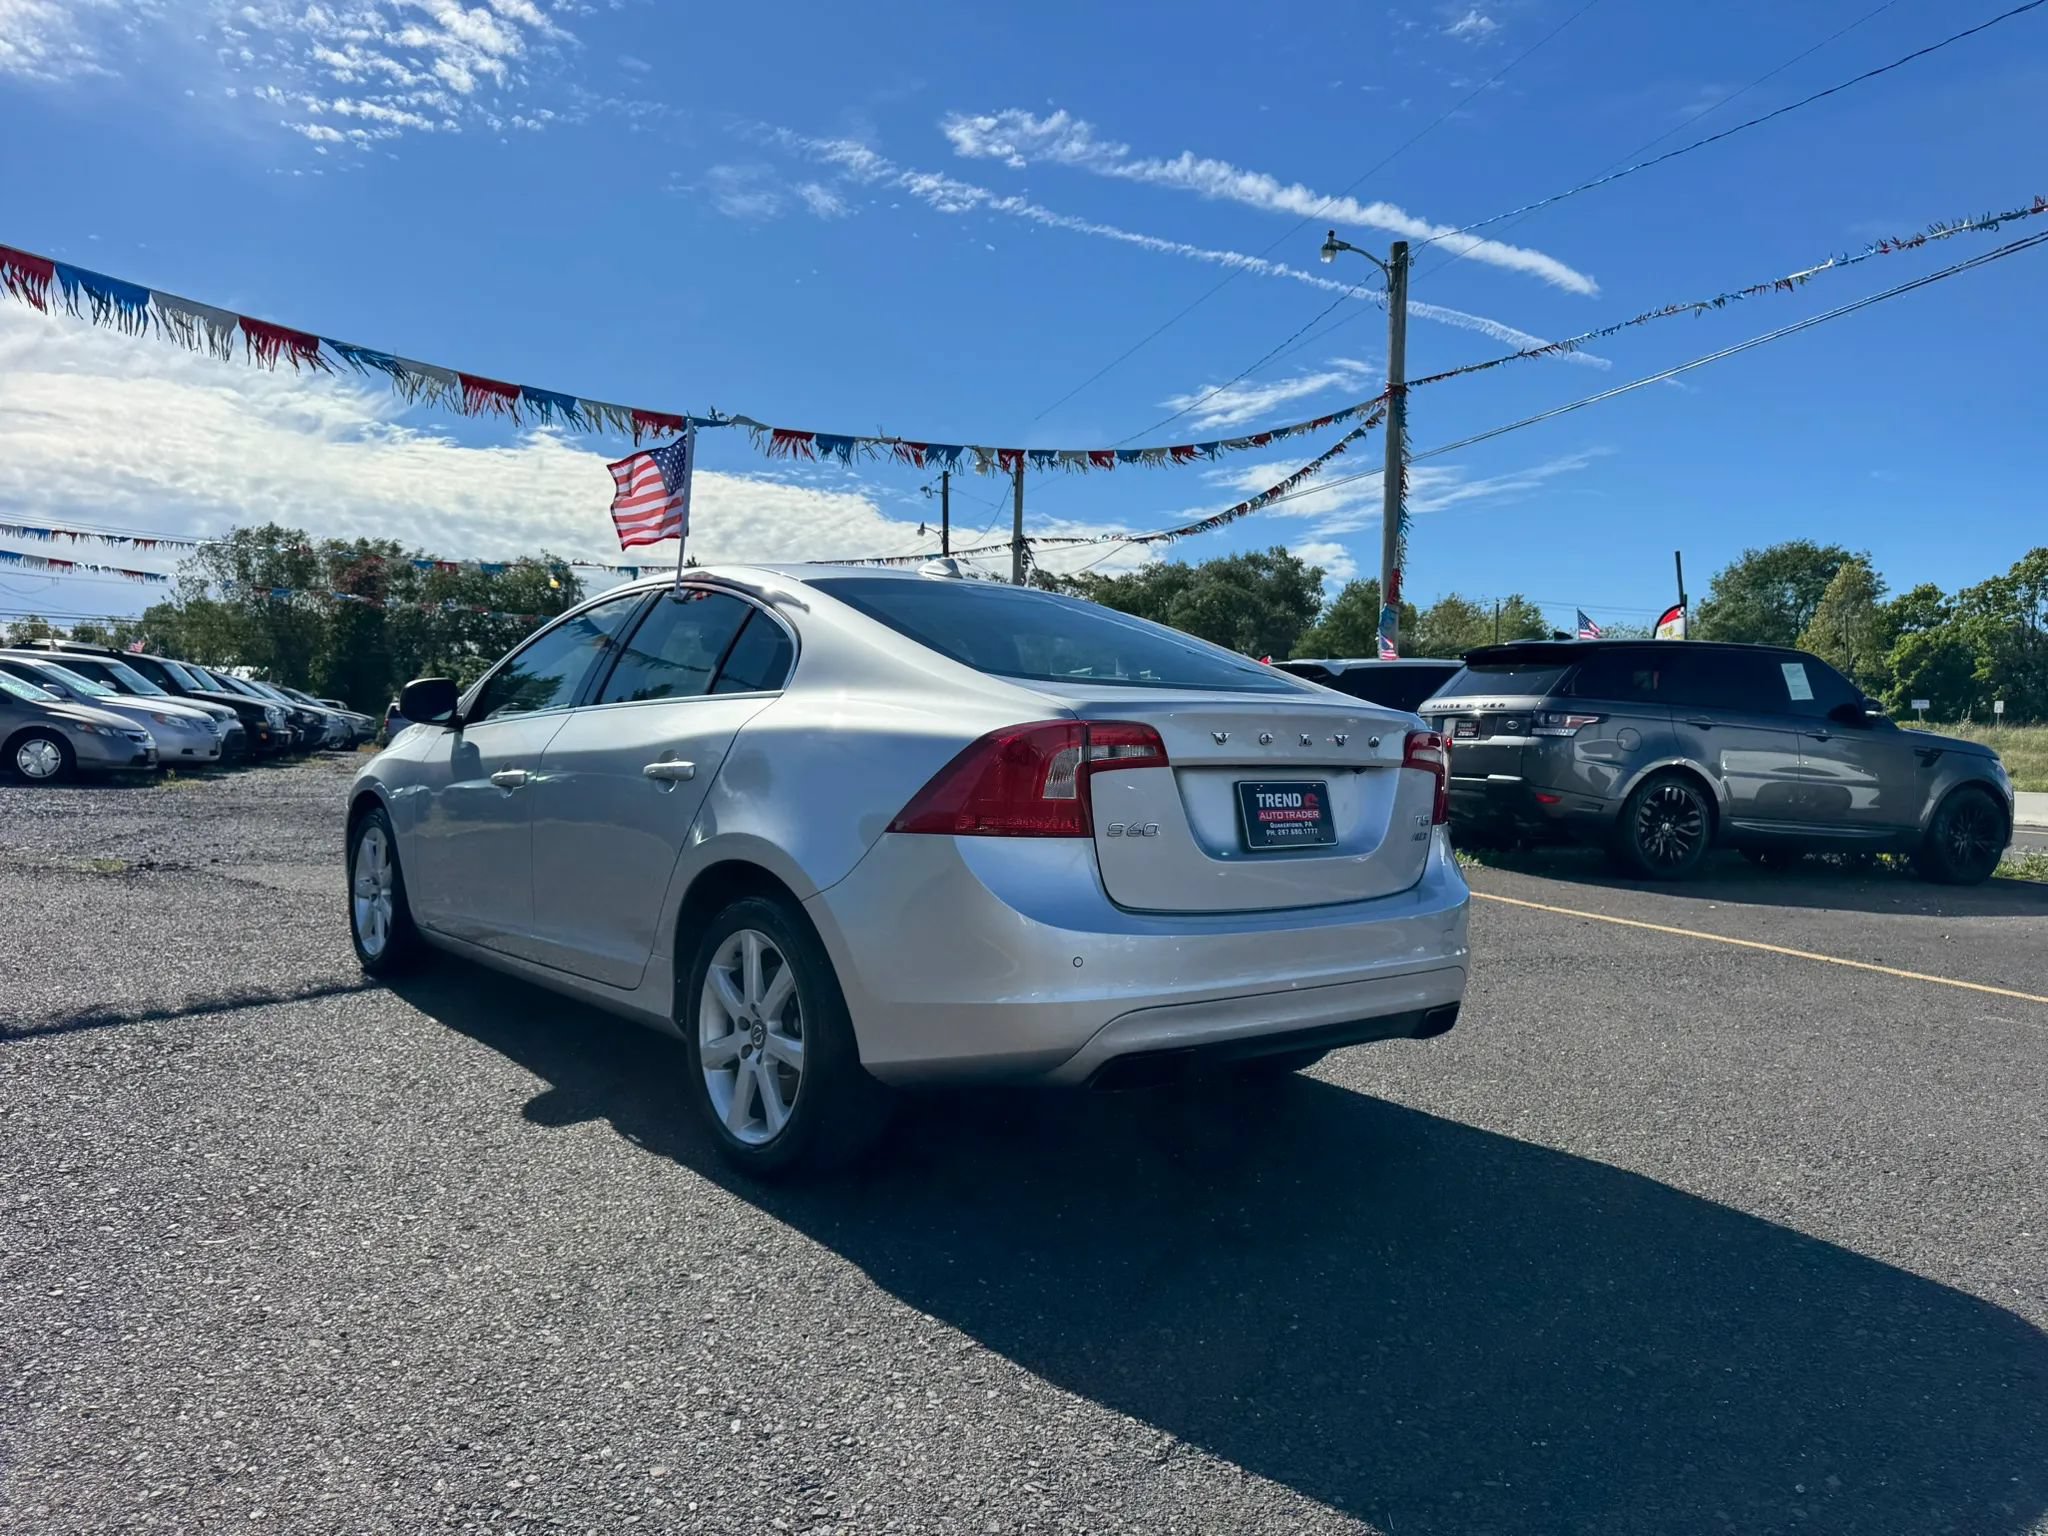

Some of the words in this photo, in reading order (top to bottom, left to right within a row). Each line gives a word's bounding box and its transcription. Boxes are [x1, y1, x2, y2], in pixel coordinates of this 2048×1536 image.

[1211, 732, 1380, 748] VOLVO
[1256, 793, 1302, 808] TREND
[1107, 821, 1160, 838] S60
